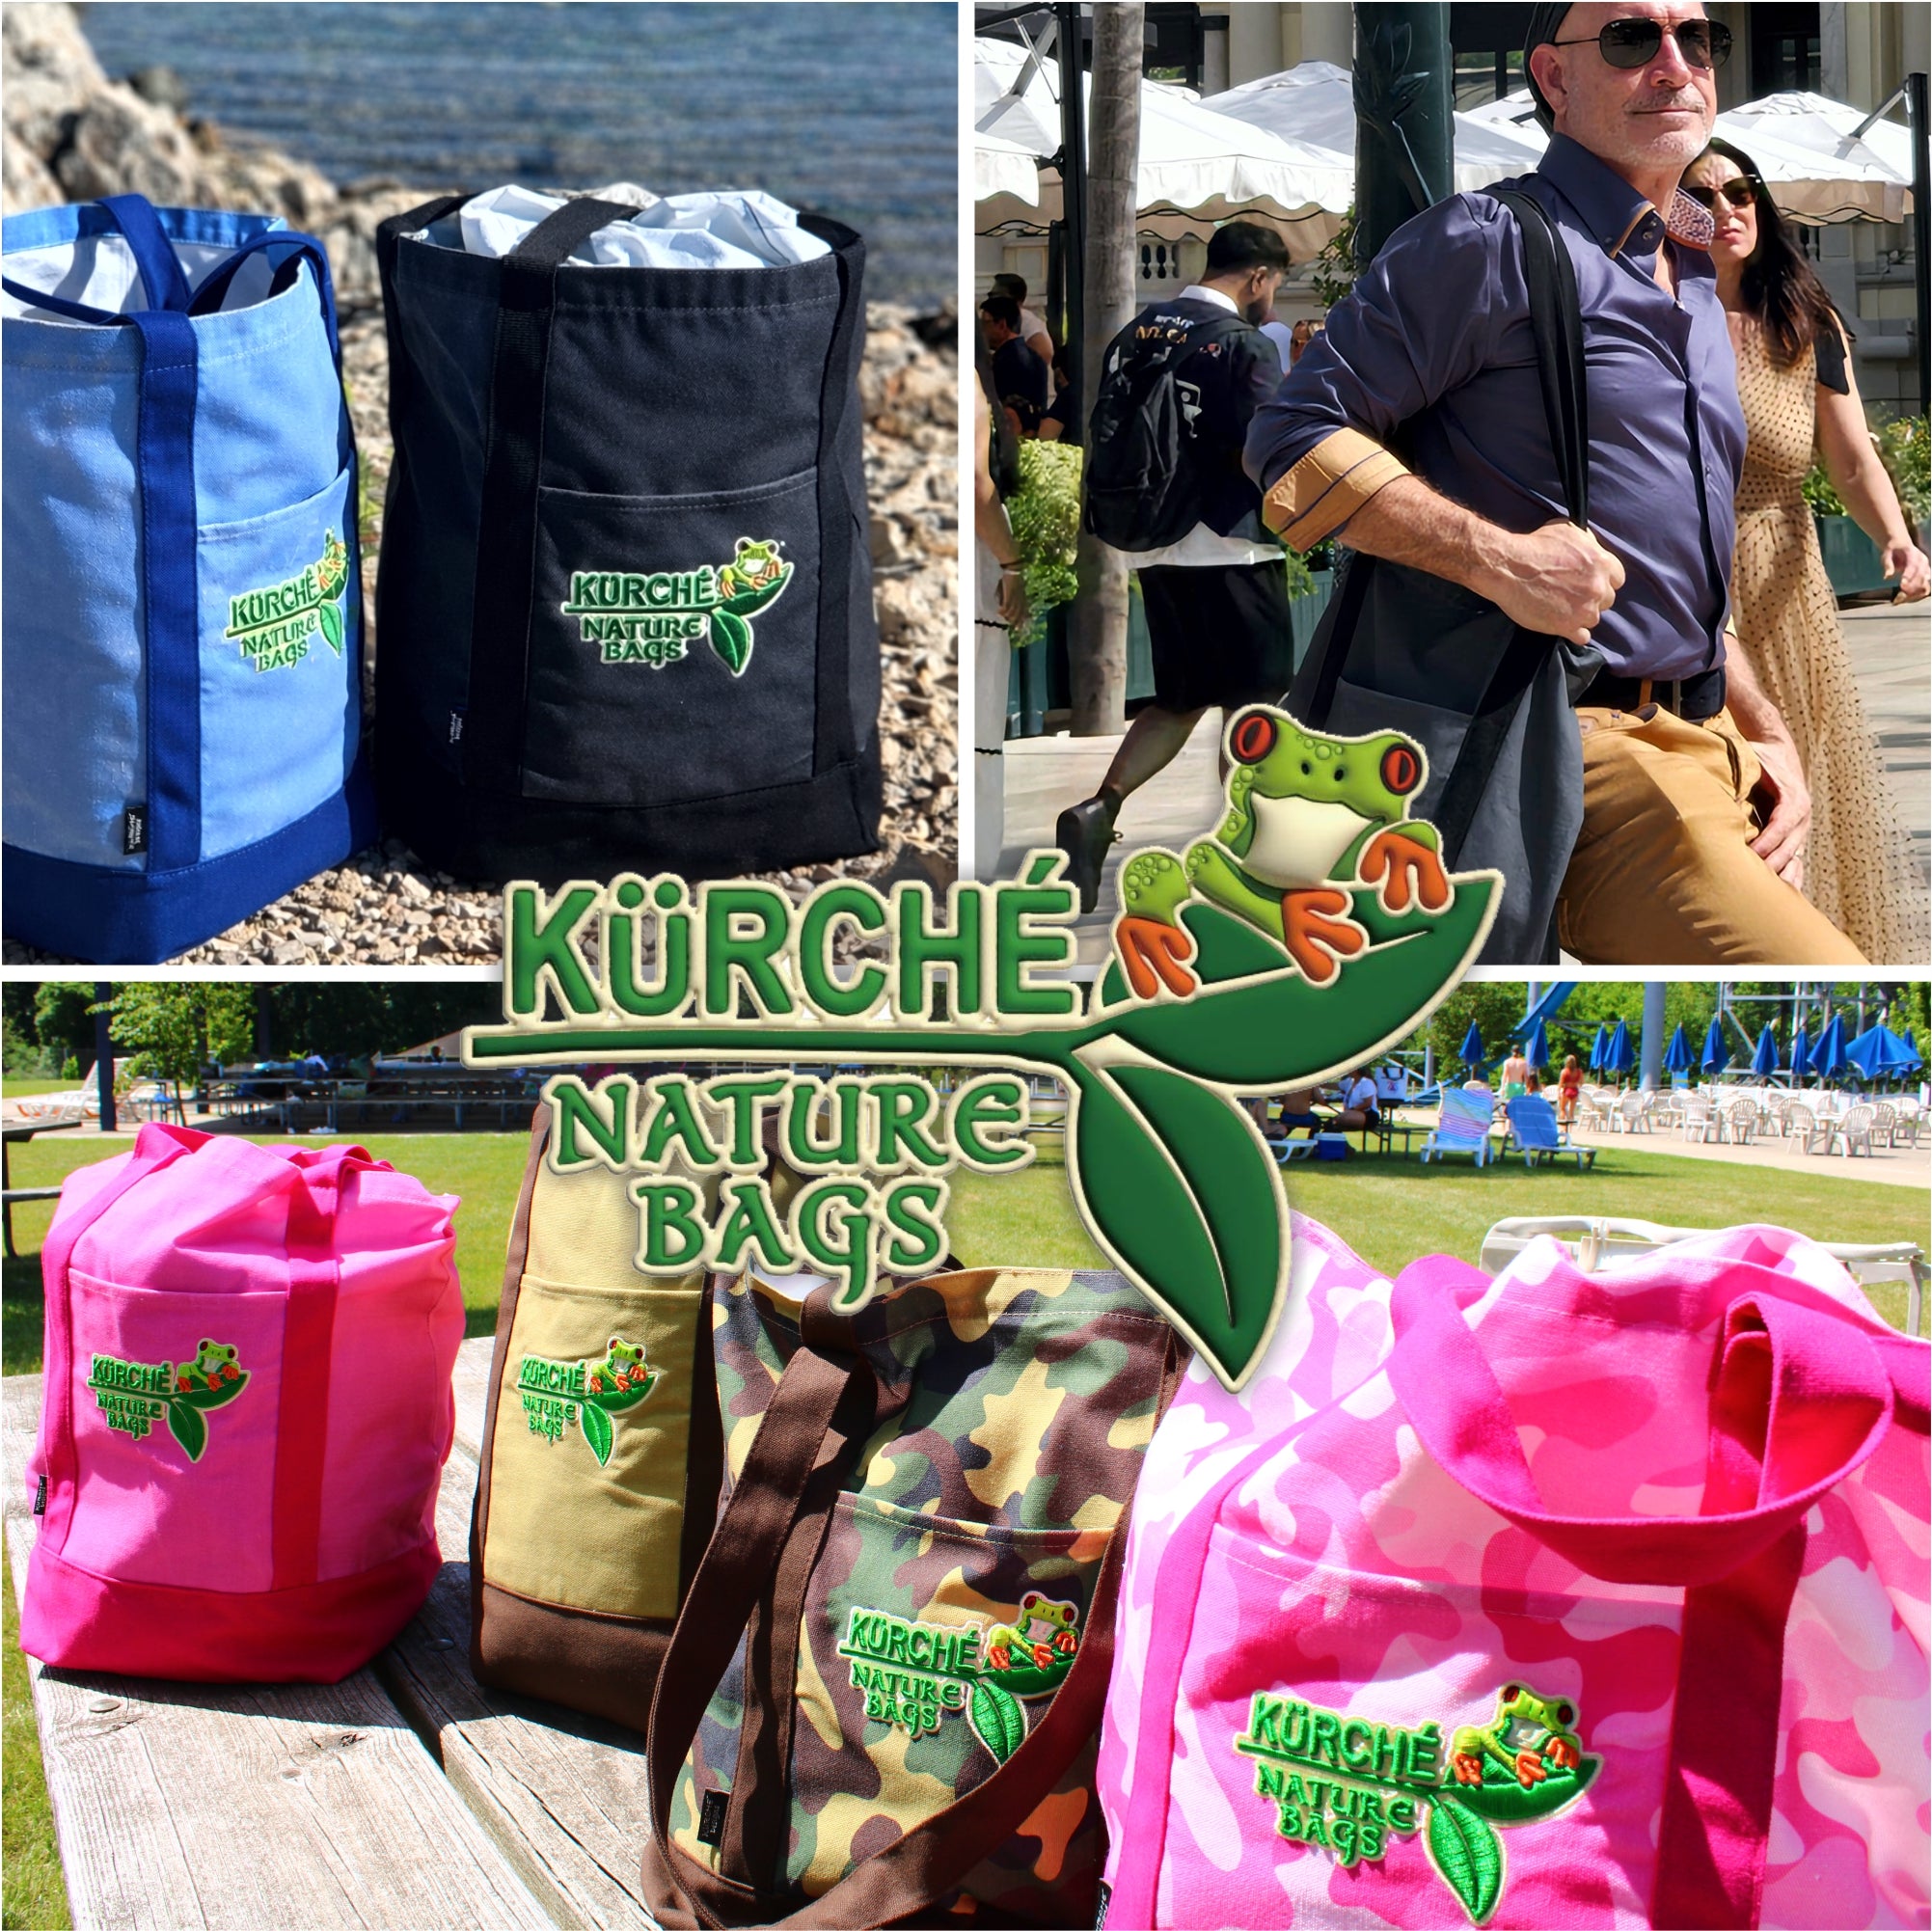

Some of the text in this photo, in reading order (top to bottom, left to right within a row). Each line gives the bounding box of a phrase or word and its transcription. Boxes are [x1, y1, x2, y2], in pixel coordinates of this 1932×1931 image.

[241, 612, 316, 658] NATURE
[583, 615, 704, 640] NATURE
[258, 639, 308, 672] BAGS
[604, 639, 683, 667] BAGS
[92, 1354, 171, 1394] KÜRCHÉ
[96, 1390, 165, 1419] NATURE
[522, 1393, 577, 1420] NATURE
[107, 1412, 150, 1439] BAGS
[528, 1413, 563, 1444] BAGS
[849, 1610, 979, 1674] KÜRCHÉ
[852, 1663, 961, 1706] NATURE
[866, 1693, 938, 1737] BAGS
[1253, 1693, 1439, 1782] KÜRCHÉ
[1257, 1763, 1418, 1831] NATURE
[1279, 1805, 1381, 1867] BAGS
